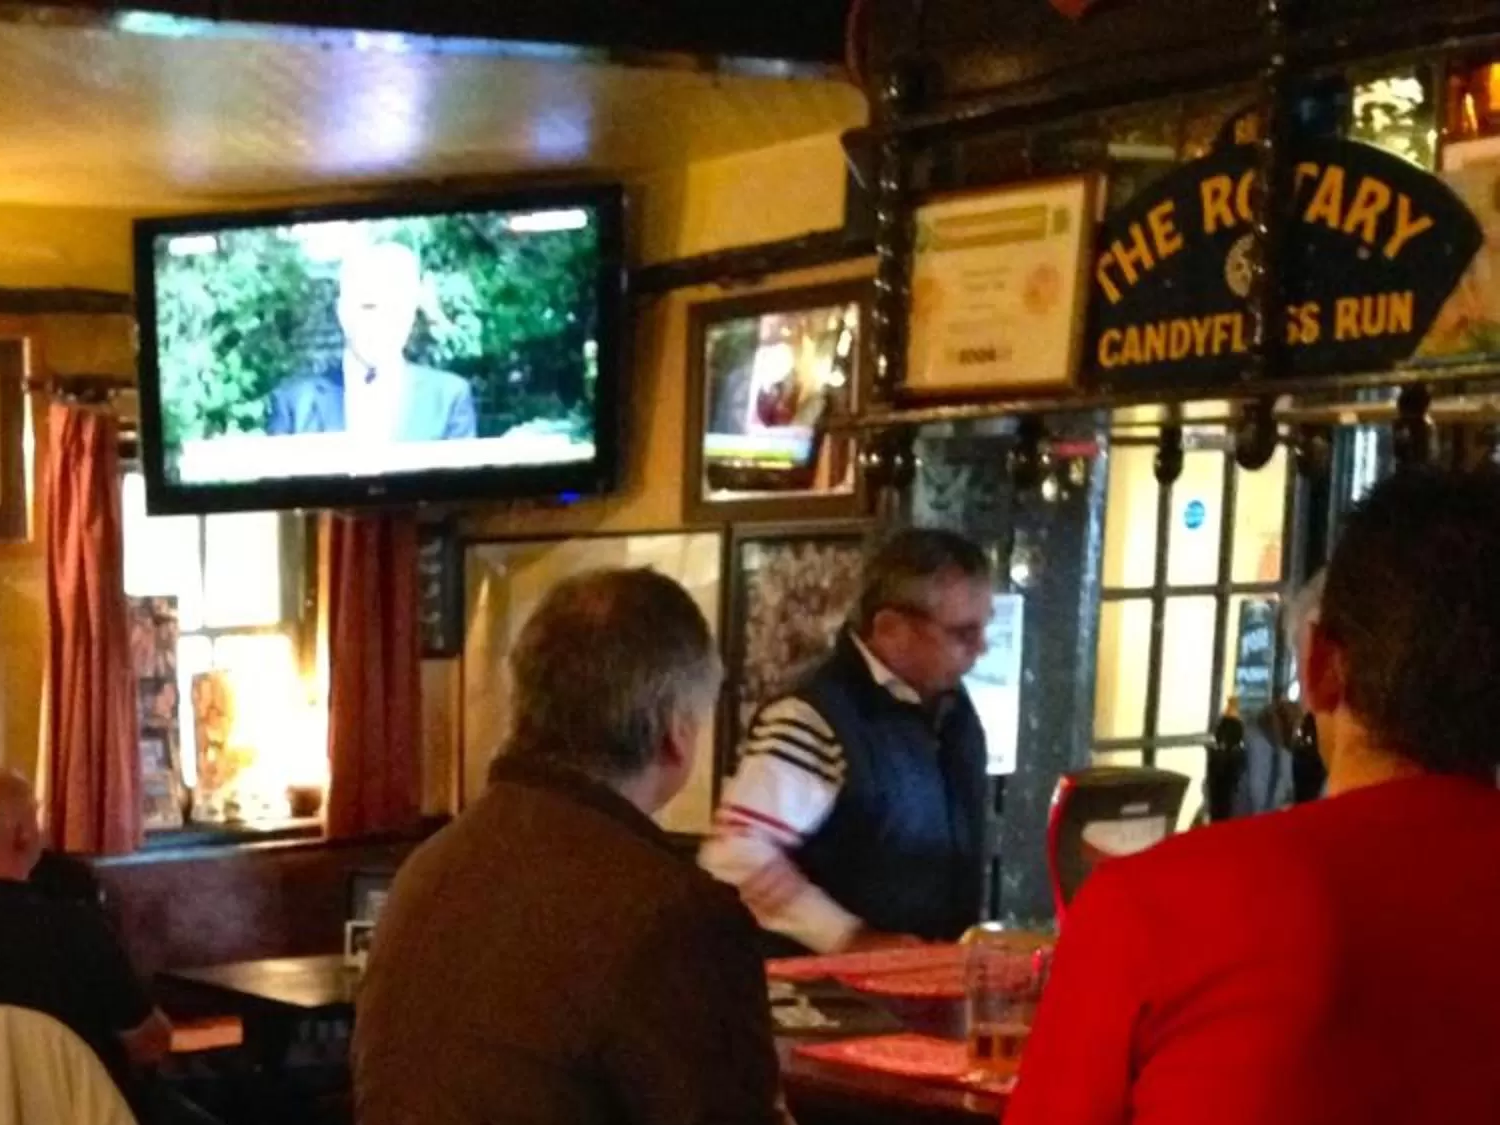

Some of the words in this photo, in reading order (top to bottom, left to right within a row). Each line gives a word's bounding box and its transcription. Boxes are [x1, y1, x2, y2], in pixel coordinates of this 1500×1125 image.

[1096, 200, 1184, 304] THE
[1097, 301, 1321, 369] CANDYFLSS
[1334, 290, 1414, 341] RUN
